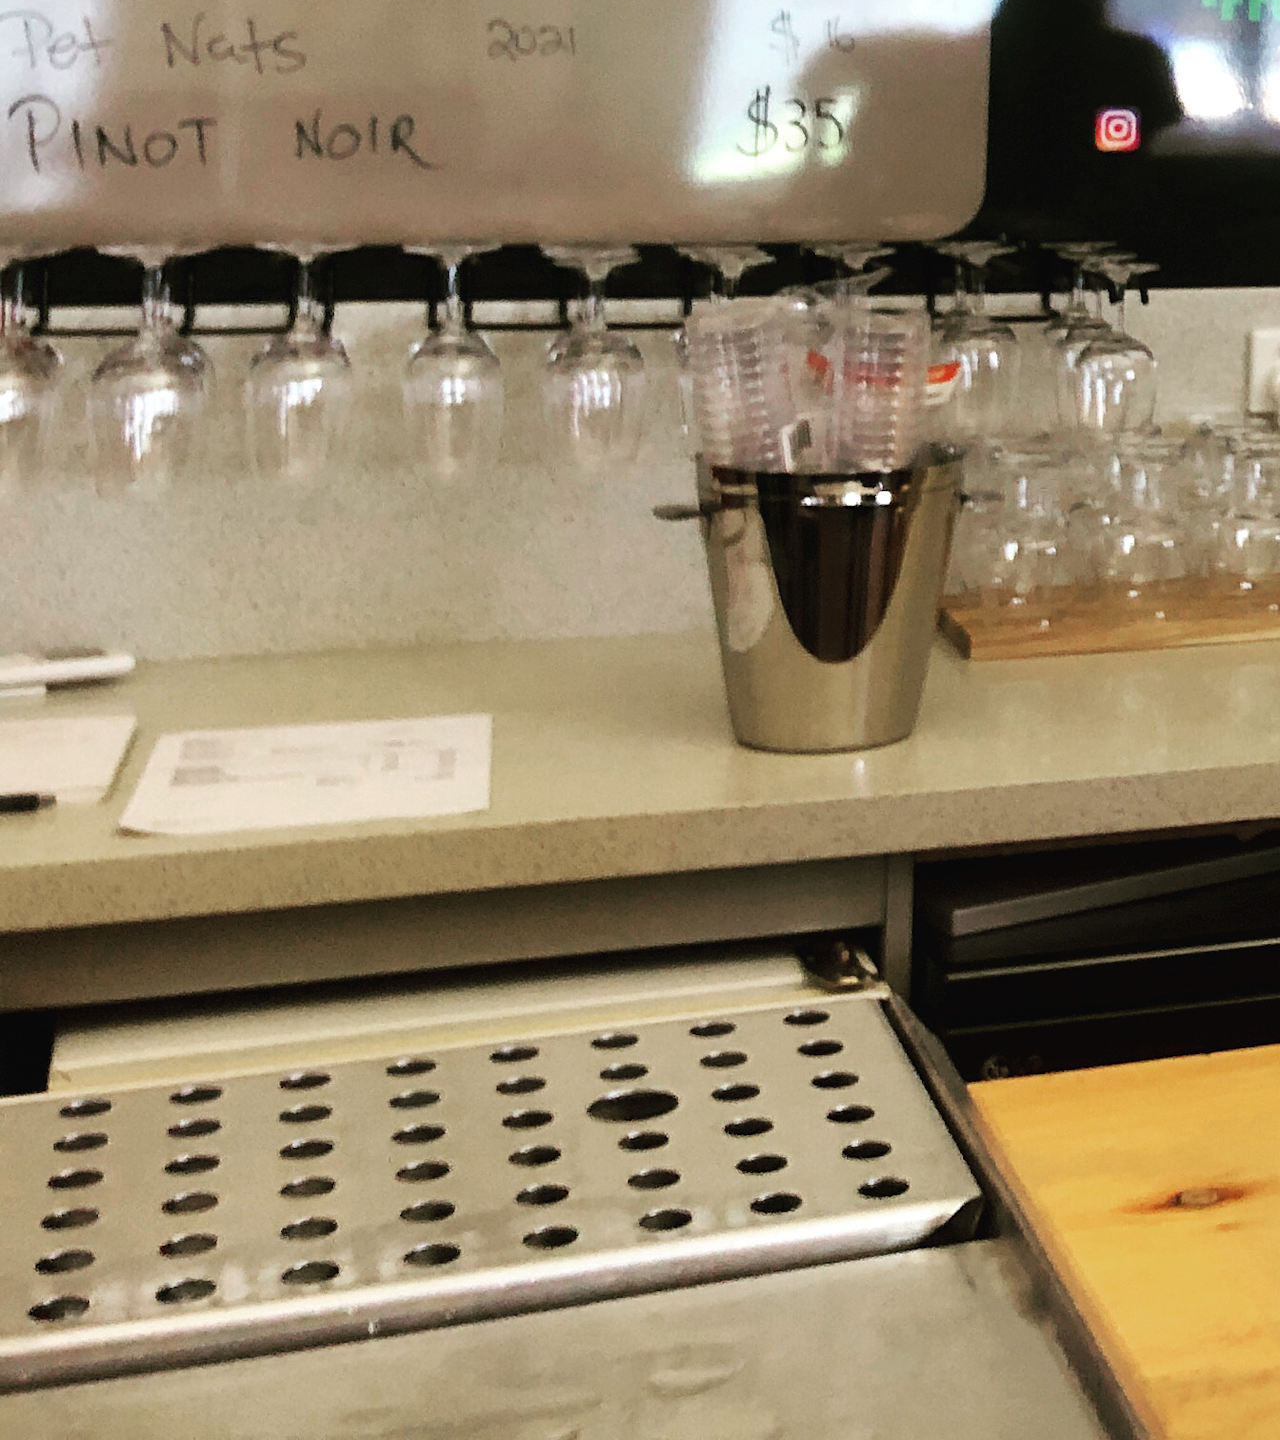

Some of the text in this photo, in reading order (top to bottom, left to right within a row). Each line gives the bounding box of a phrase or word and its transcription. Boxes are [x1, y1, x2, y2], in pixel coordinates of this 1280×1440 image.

[160, 12, 307, 75] Nats
[487, 18, 577, 63] 2021
[7, 83, 846, 176] PINOT NOIR $35
